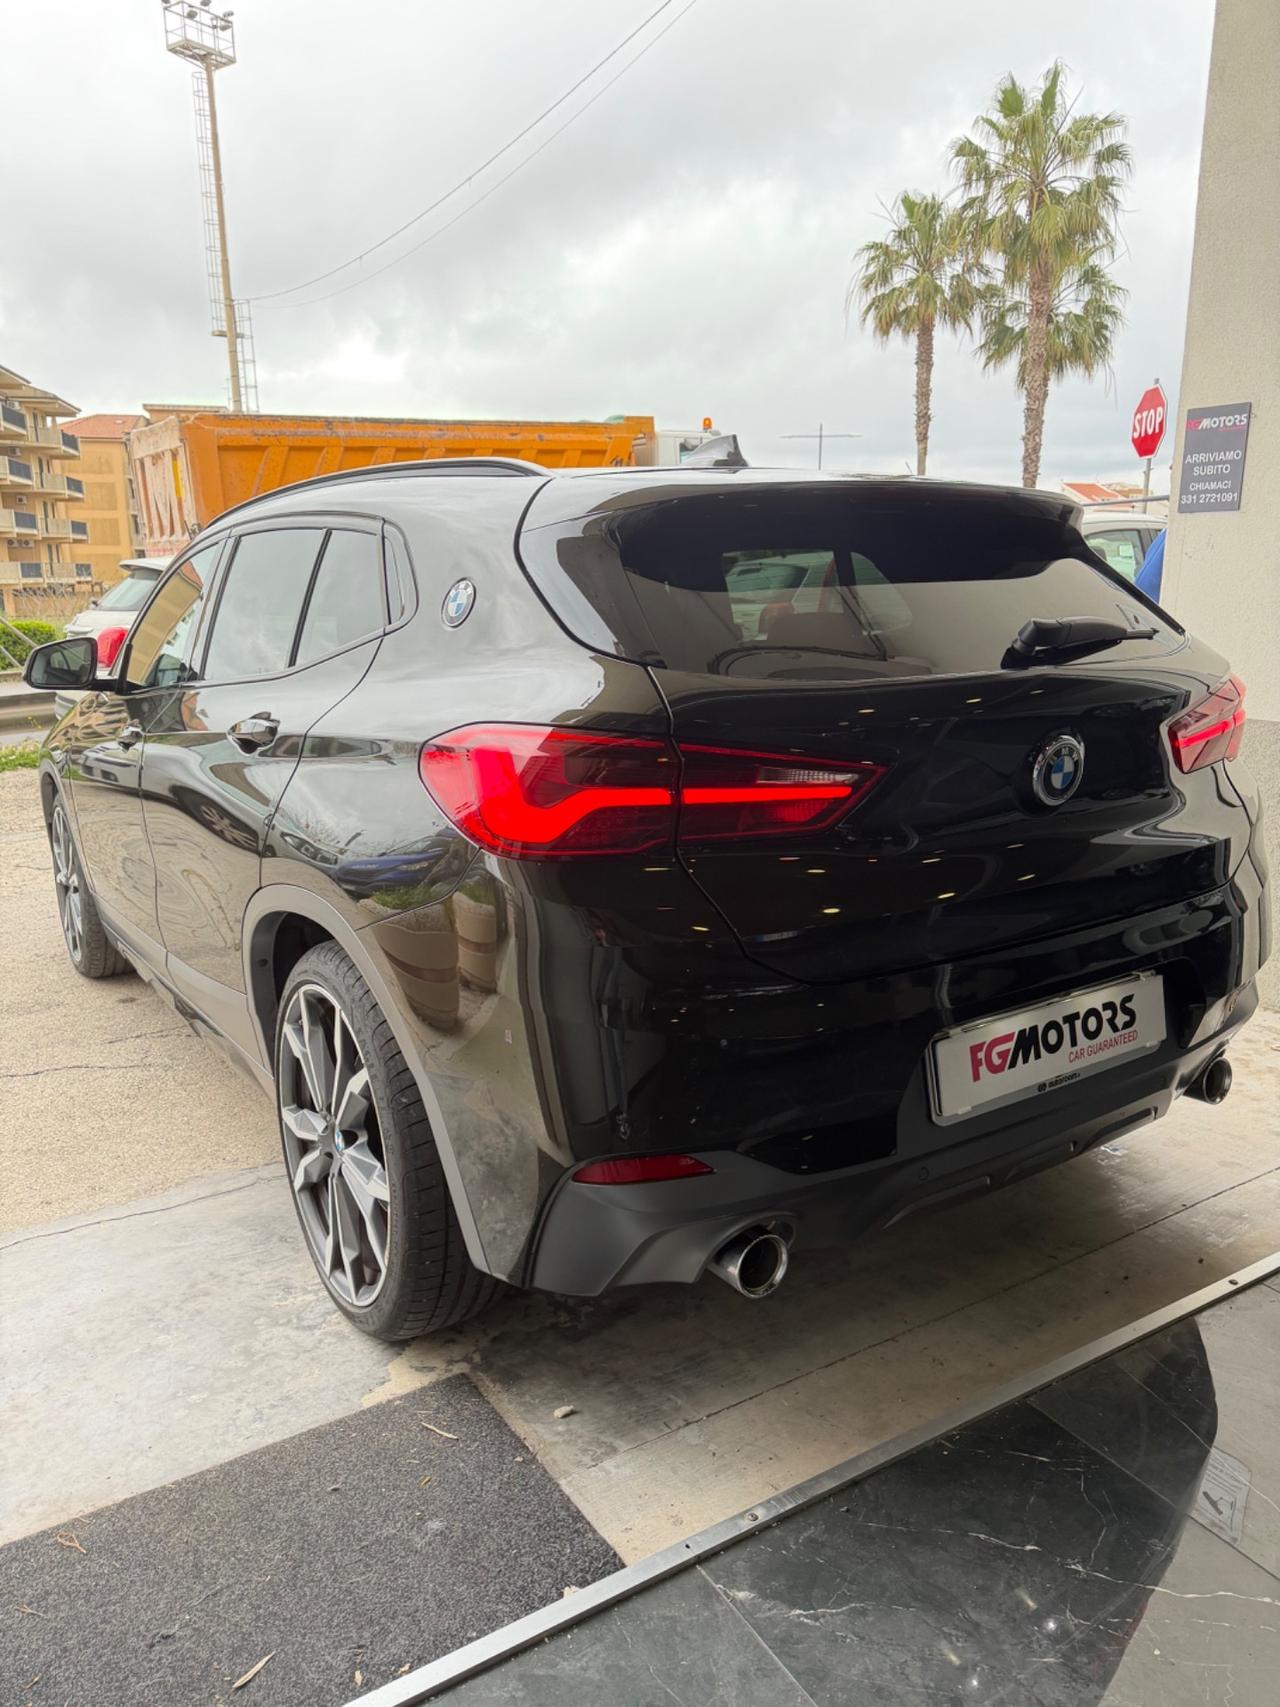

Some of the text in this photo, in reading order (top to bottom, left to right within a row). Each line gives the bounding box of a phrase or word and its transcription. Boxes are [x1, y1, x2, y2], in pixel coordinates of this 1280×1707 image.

[1133, 406, 1163, 439] STOP
[1185, 450, 1242, 464] ARRIVIAMO
[1193, 464, 1231, 476] SUBITO
[1181, 492, 1238, 504] 331 2721091
[1068, 1030, 1138, 1063] CAR GUARANTEED
